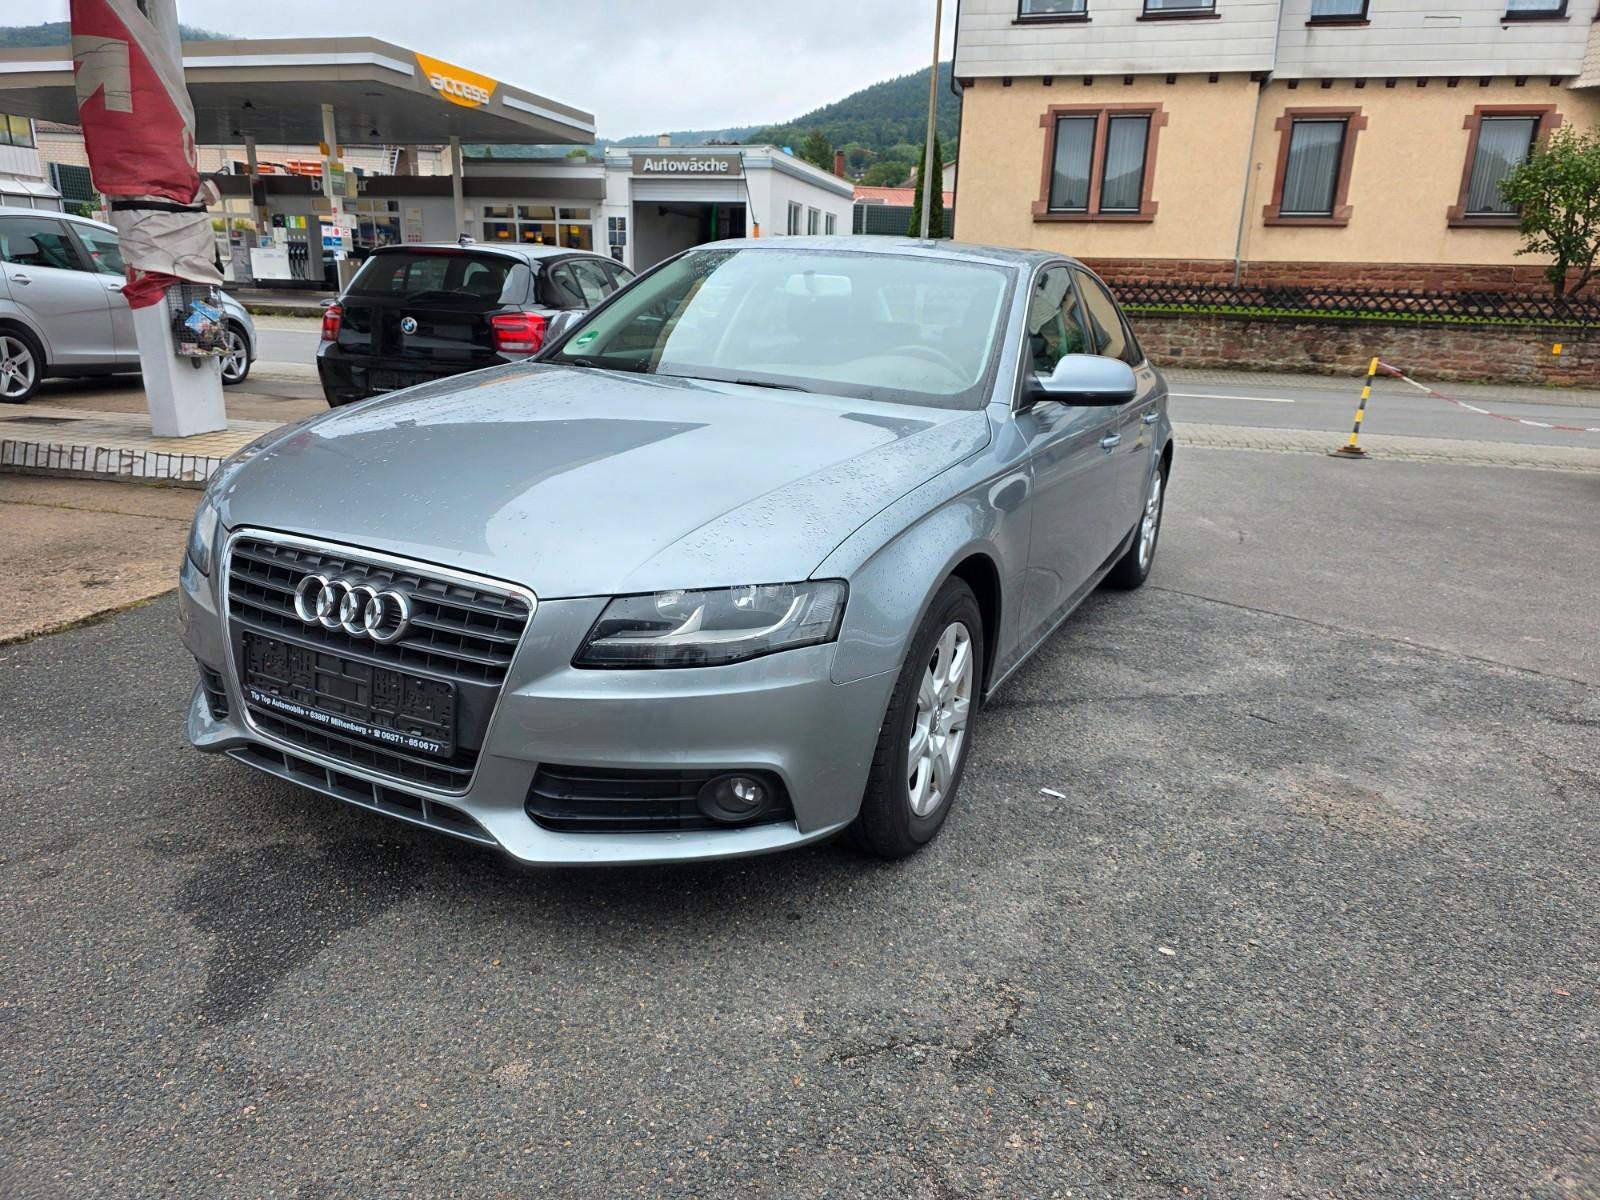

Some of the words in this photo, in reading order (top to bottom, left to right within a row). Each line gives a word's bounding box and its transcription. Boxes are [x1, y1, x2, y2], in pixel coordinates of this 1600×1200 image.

[430, 73, 490, 105] access
[643, 157, 729, 172] Autowäsche
[251, 690, 260, 701] Tip
[261, 694, 271, 705] Top
[272, 698, 305, 716] Automobile
